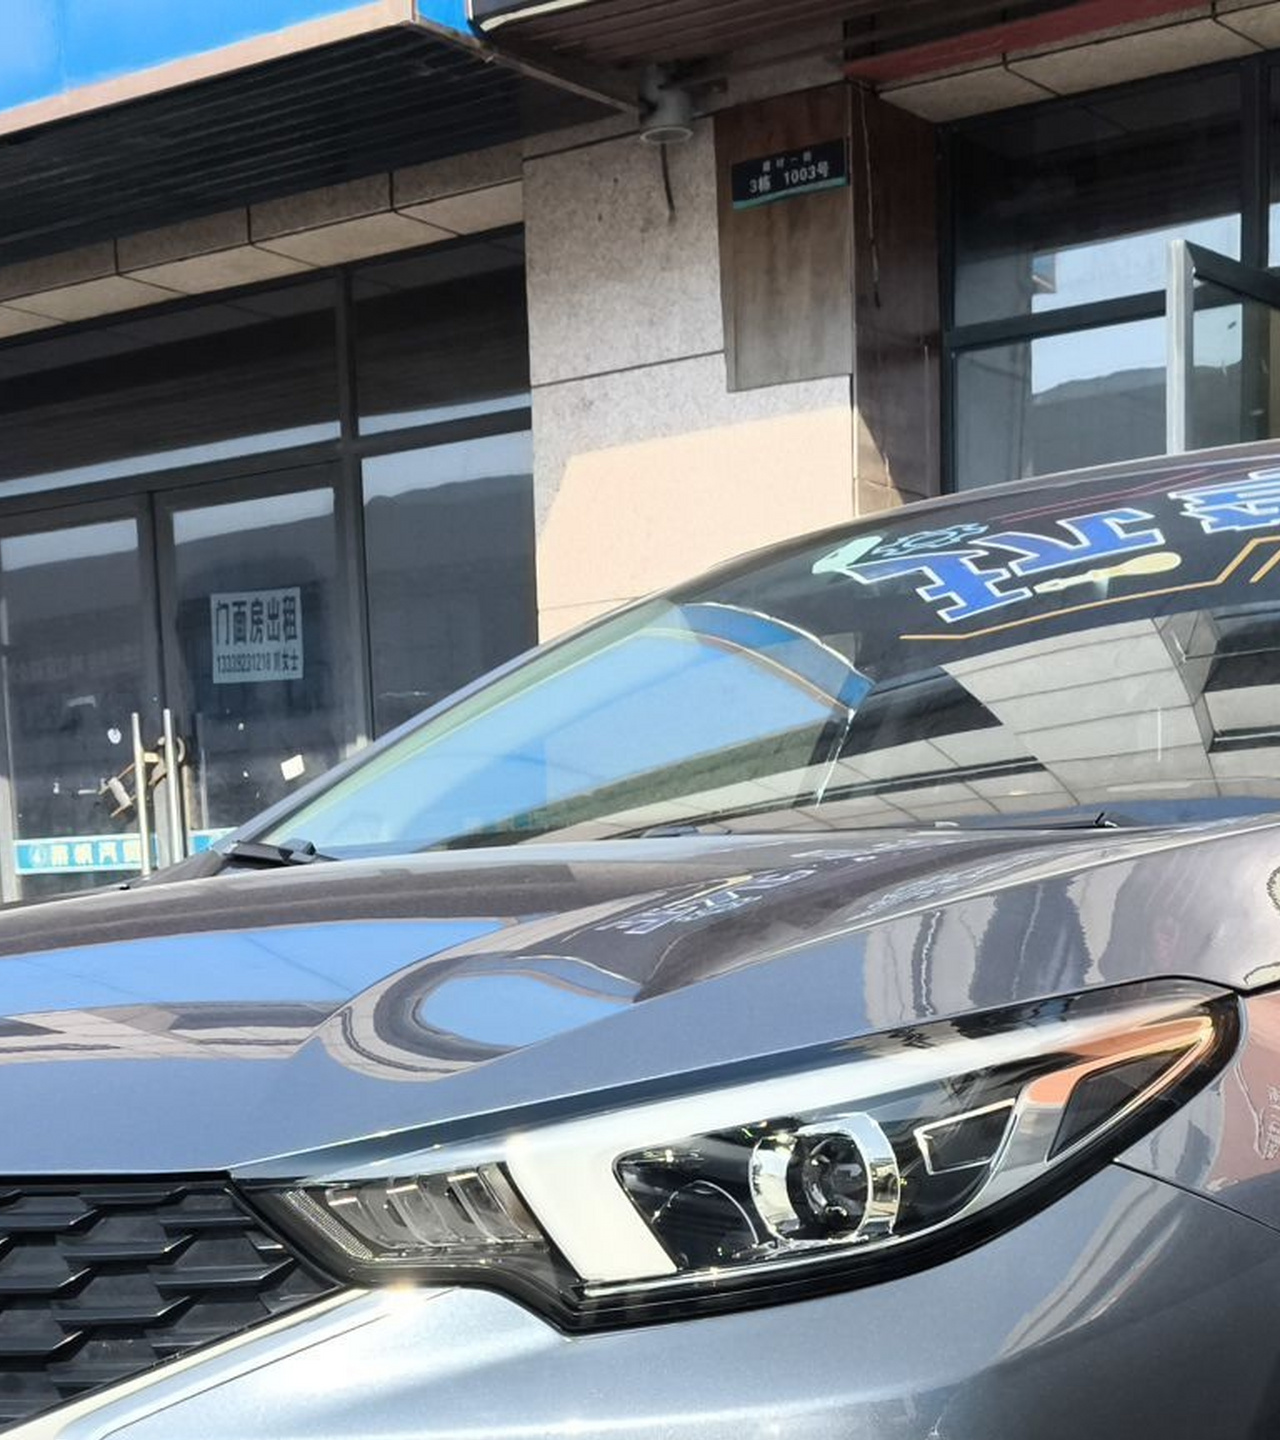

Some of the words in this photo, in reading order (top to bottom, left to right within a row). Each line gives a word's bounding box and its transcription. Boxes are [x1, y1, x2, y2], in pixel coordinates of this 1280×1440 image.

[784, 161, 829, 186] 1003号
[215, 596, 298, 645] 门面房出租
